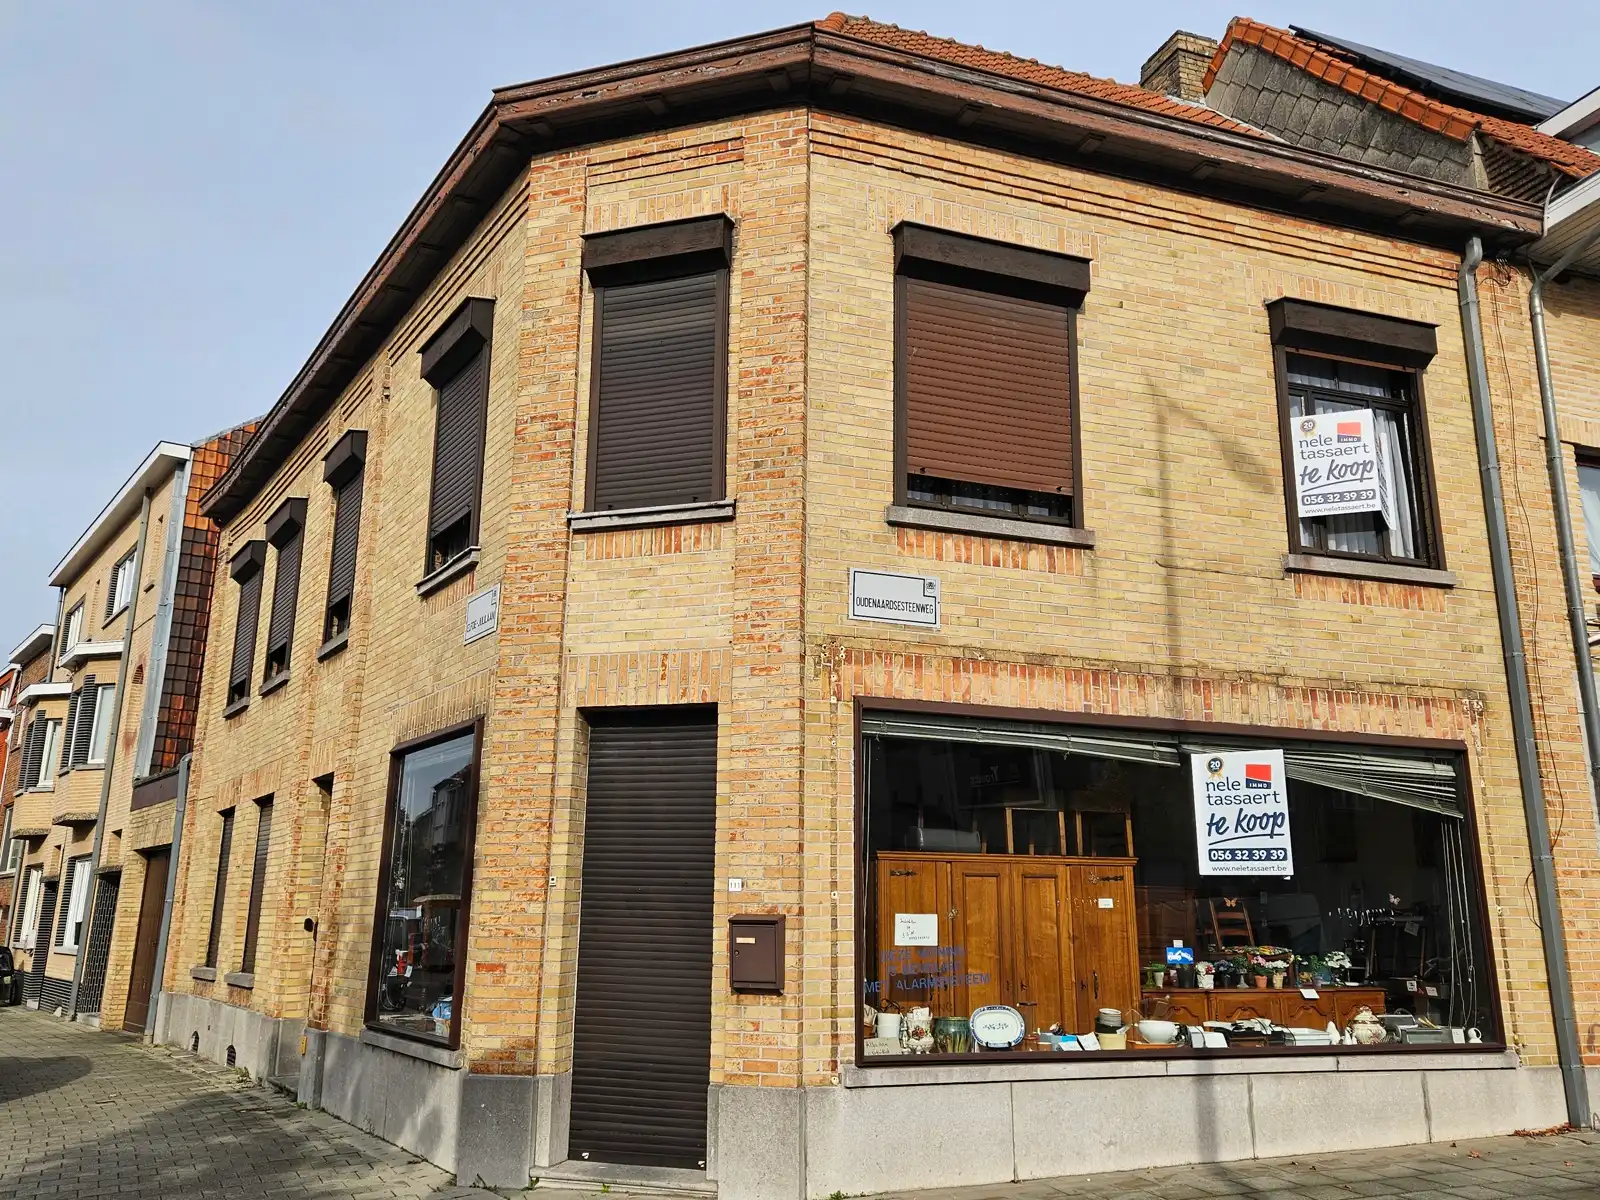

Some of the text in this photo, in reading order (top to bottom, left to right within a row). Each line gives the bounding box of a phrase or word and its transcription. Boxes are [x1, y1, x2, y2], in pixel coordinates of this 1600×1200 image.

[1303, 420, 1314, 429] 20
[1299, 435, 1333, 449] nele
[1300, 443, 1370, 460] tassaert
[1299, 459, 1375, 486] te koop
[1303, 490, 1374, 505] 056 32 39 39
[1304, 503, 1376, 514] www.neletassaert.be
[855, 596, 934, 614] OUDENAARDSESTEENWEG
[1209, 760, 1221, 769] 20
[1205, 777, 1241, 792] nele
[1206, 791, 1281, 806] tassaert
[1206, 807, 1286, 839] te koop
[1210, 850, 1285, 861] 056 32 39 39
[1211, 864, 1287, 873] www.neletassaert.be
[864, 973, 991, 994] MET ALARMSYSTEEM
